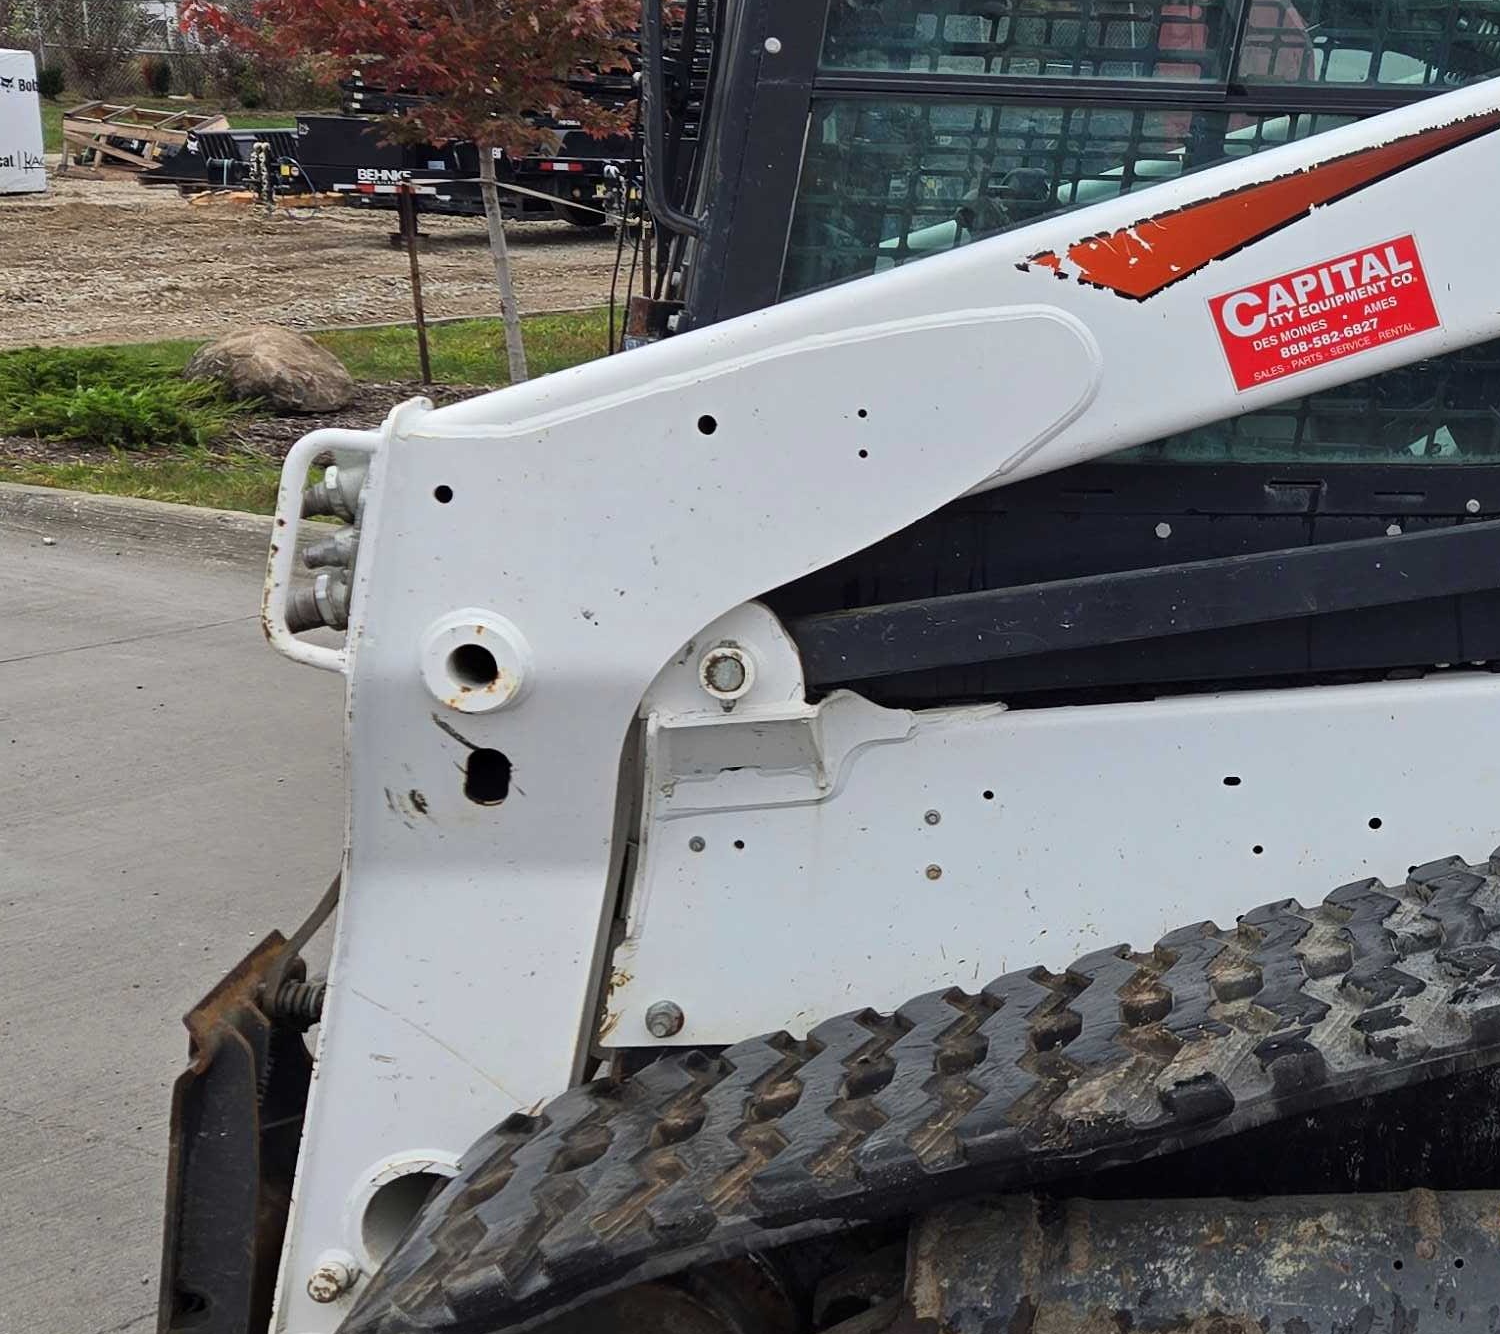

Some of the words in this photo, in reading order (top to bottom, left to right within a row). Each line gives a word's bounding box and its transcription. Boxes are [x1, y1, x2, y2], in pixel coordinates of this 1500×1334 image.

[1222, 246, 1414, 337] CAPITAL
[1298, 280, 1387, 319] EQUIPMENT
[1253, 335, 1279, 351] DES
[1280, 319, 1328, 343] MOINES
[1363, 296, 1398, 316] AMES
[1280, 317, 1378, 358] 888-582-6827
[1254, 364, 1285, 381] SALES
[1291, 351, 1324, 369] PARTS
[1329, 336, 1372, 356] SERVICE
[1378, 323, 1416, 342] RENTAL
